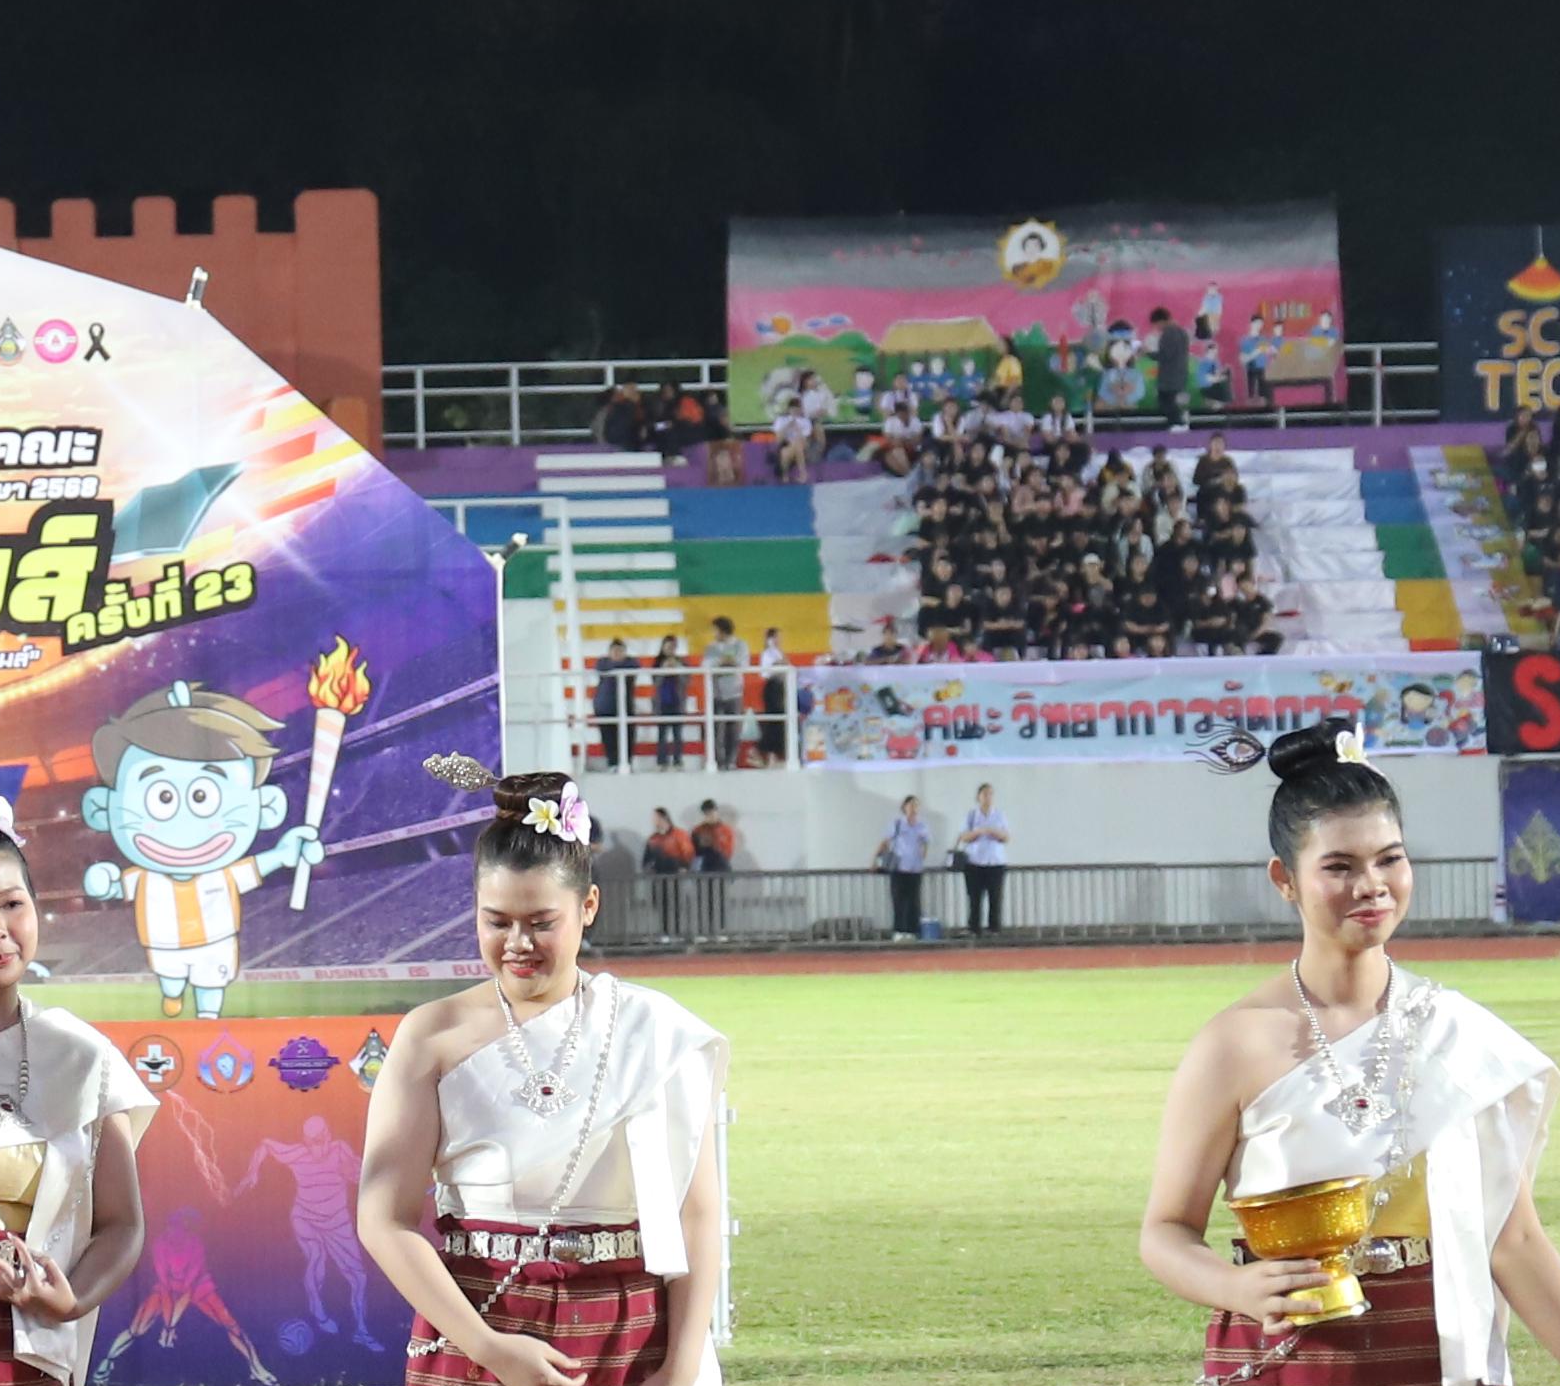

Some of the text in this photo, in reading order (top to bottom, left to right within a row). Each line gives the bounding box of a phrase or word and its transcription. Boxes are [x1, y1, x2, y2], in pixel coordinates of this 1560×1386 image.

[64, 570, 255, 645] ครั้งที่ 23
